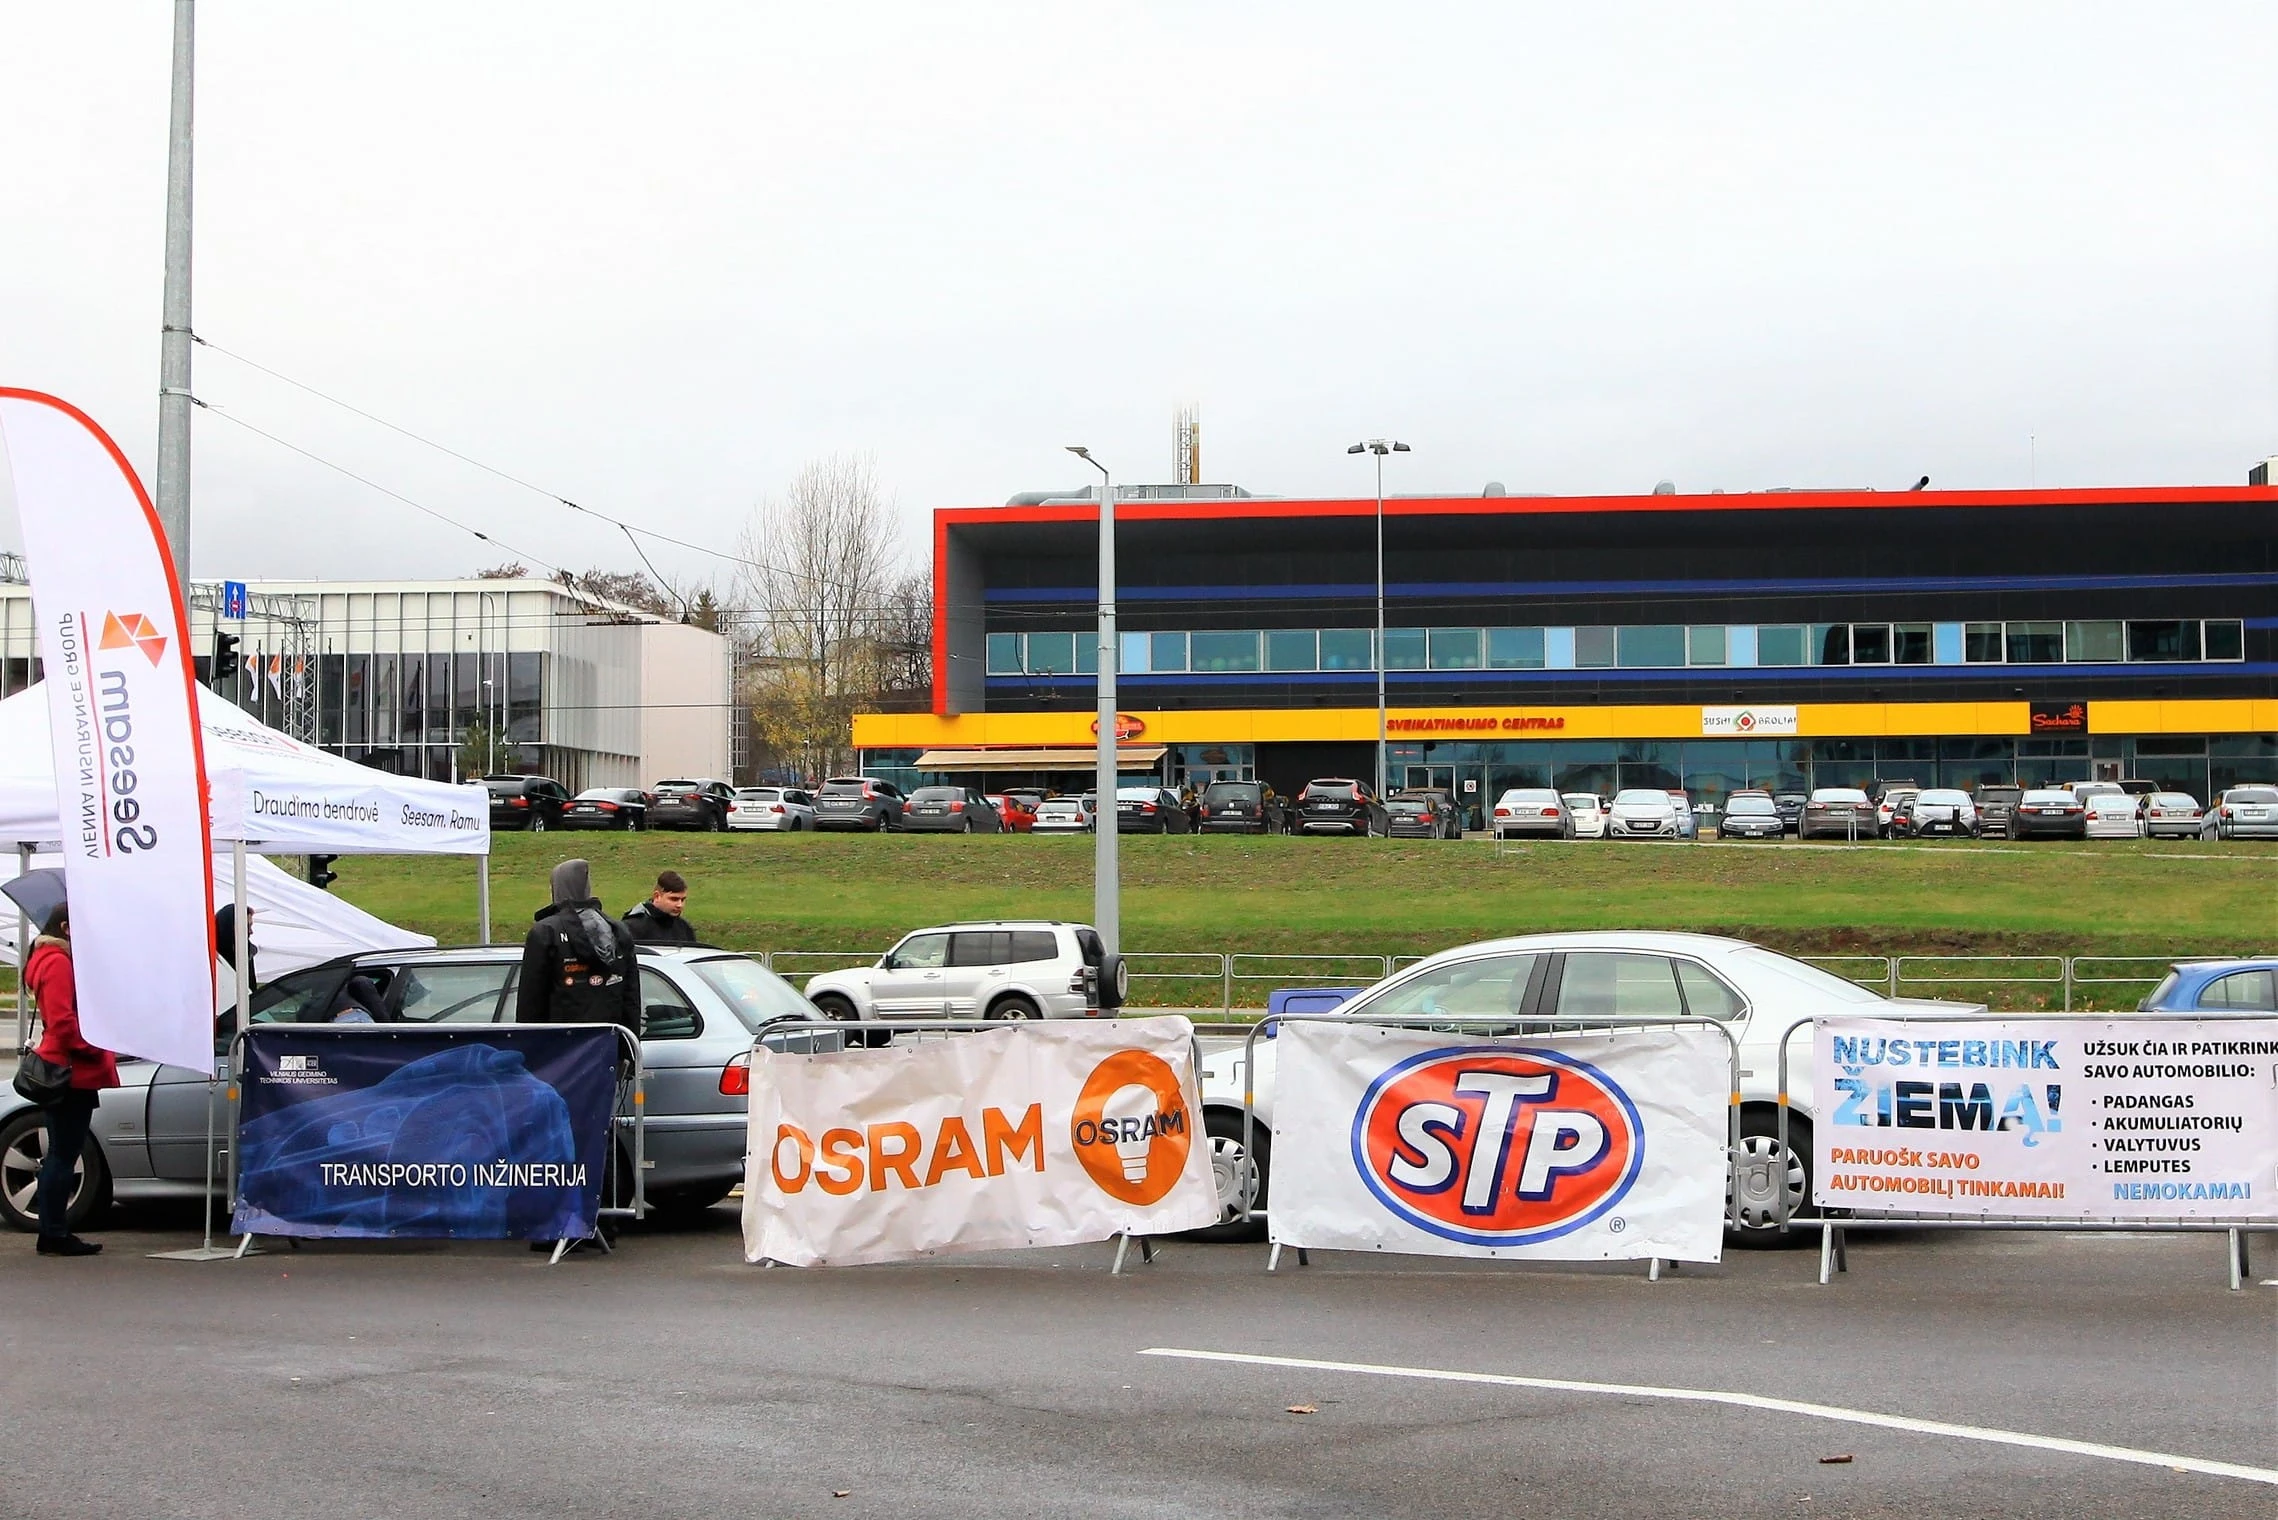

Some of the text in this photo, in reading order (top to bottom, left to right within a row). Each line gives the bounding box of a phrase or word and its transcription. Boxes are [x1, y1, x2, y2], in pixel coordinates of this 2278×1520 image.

[1386, 717, 1565, 732] SVEIKATINGUMO CENTRAS
[1703, 716, 1731, 726] SUSHI
[2032, 713, 2081, 727] Sachara
[253, 790, 320, 819] Draudimo
[323, 796, 379, 823] bendrovė
[400, 803, 446, 829] Seesam.
[1833, 1036, 2060, 1069] NUSTEBINK
[2083, 1039, 2278, 1057] UŽSUK ČIA IR PATIKRINK
[2083, 1064, 2255, 1079] SAVO AUTOMOBILIO:
[1832, 1066, 2062, 1148] ŽIEMĄ!
[2103, 1095, 2194, 1109] PADANGAS
[1074, 1108, 1185, 1147] OSRAM
[2103, 1116, 2243, 1134] AKUMULIATORIŲ
[771, 1103, 1046, 1196] OSRAM
[1387, 1070, 1612, 1216] STP
[2103, 1138, 2201, 1152] VALYTUVUS
[1831, 1147, 1980, 1170] PARUOŠK SAVO
[2104, 1159, 2191, 1174] LEMPUTES
[319, 1158, 587, 1187] TRANSPORTO INŽINERIJA
[1830, 1175, 2065, 1199] AUTOMOBILĮ TINKAMAI!
[2113, 1182, 2251, 1200] NEMOKAMAI
